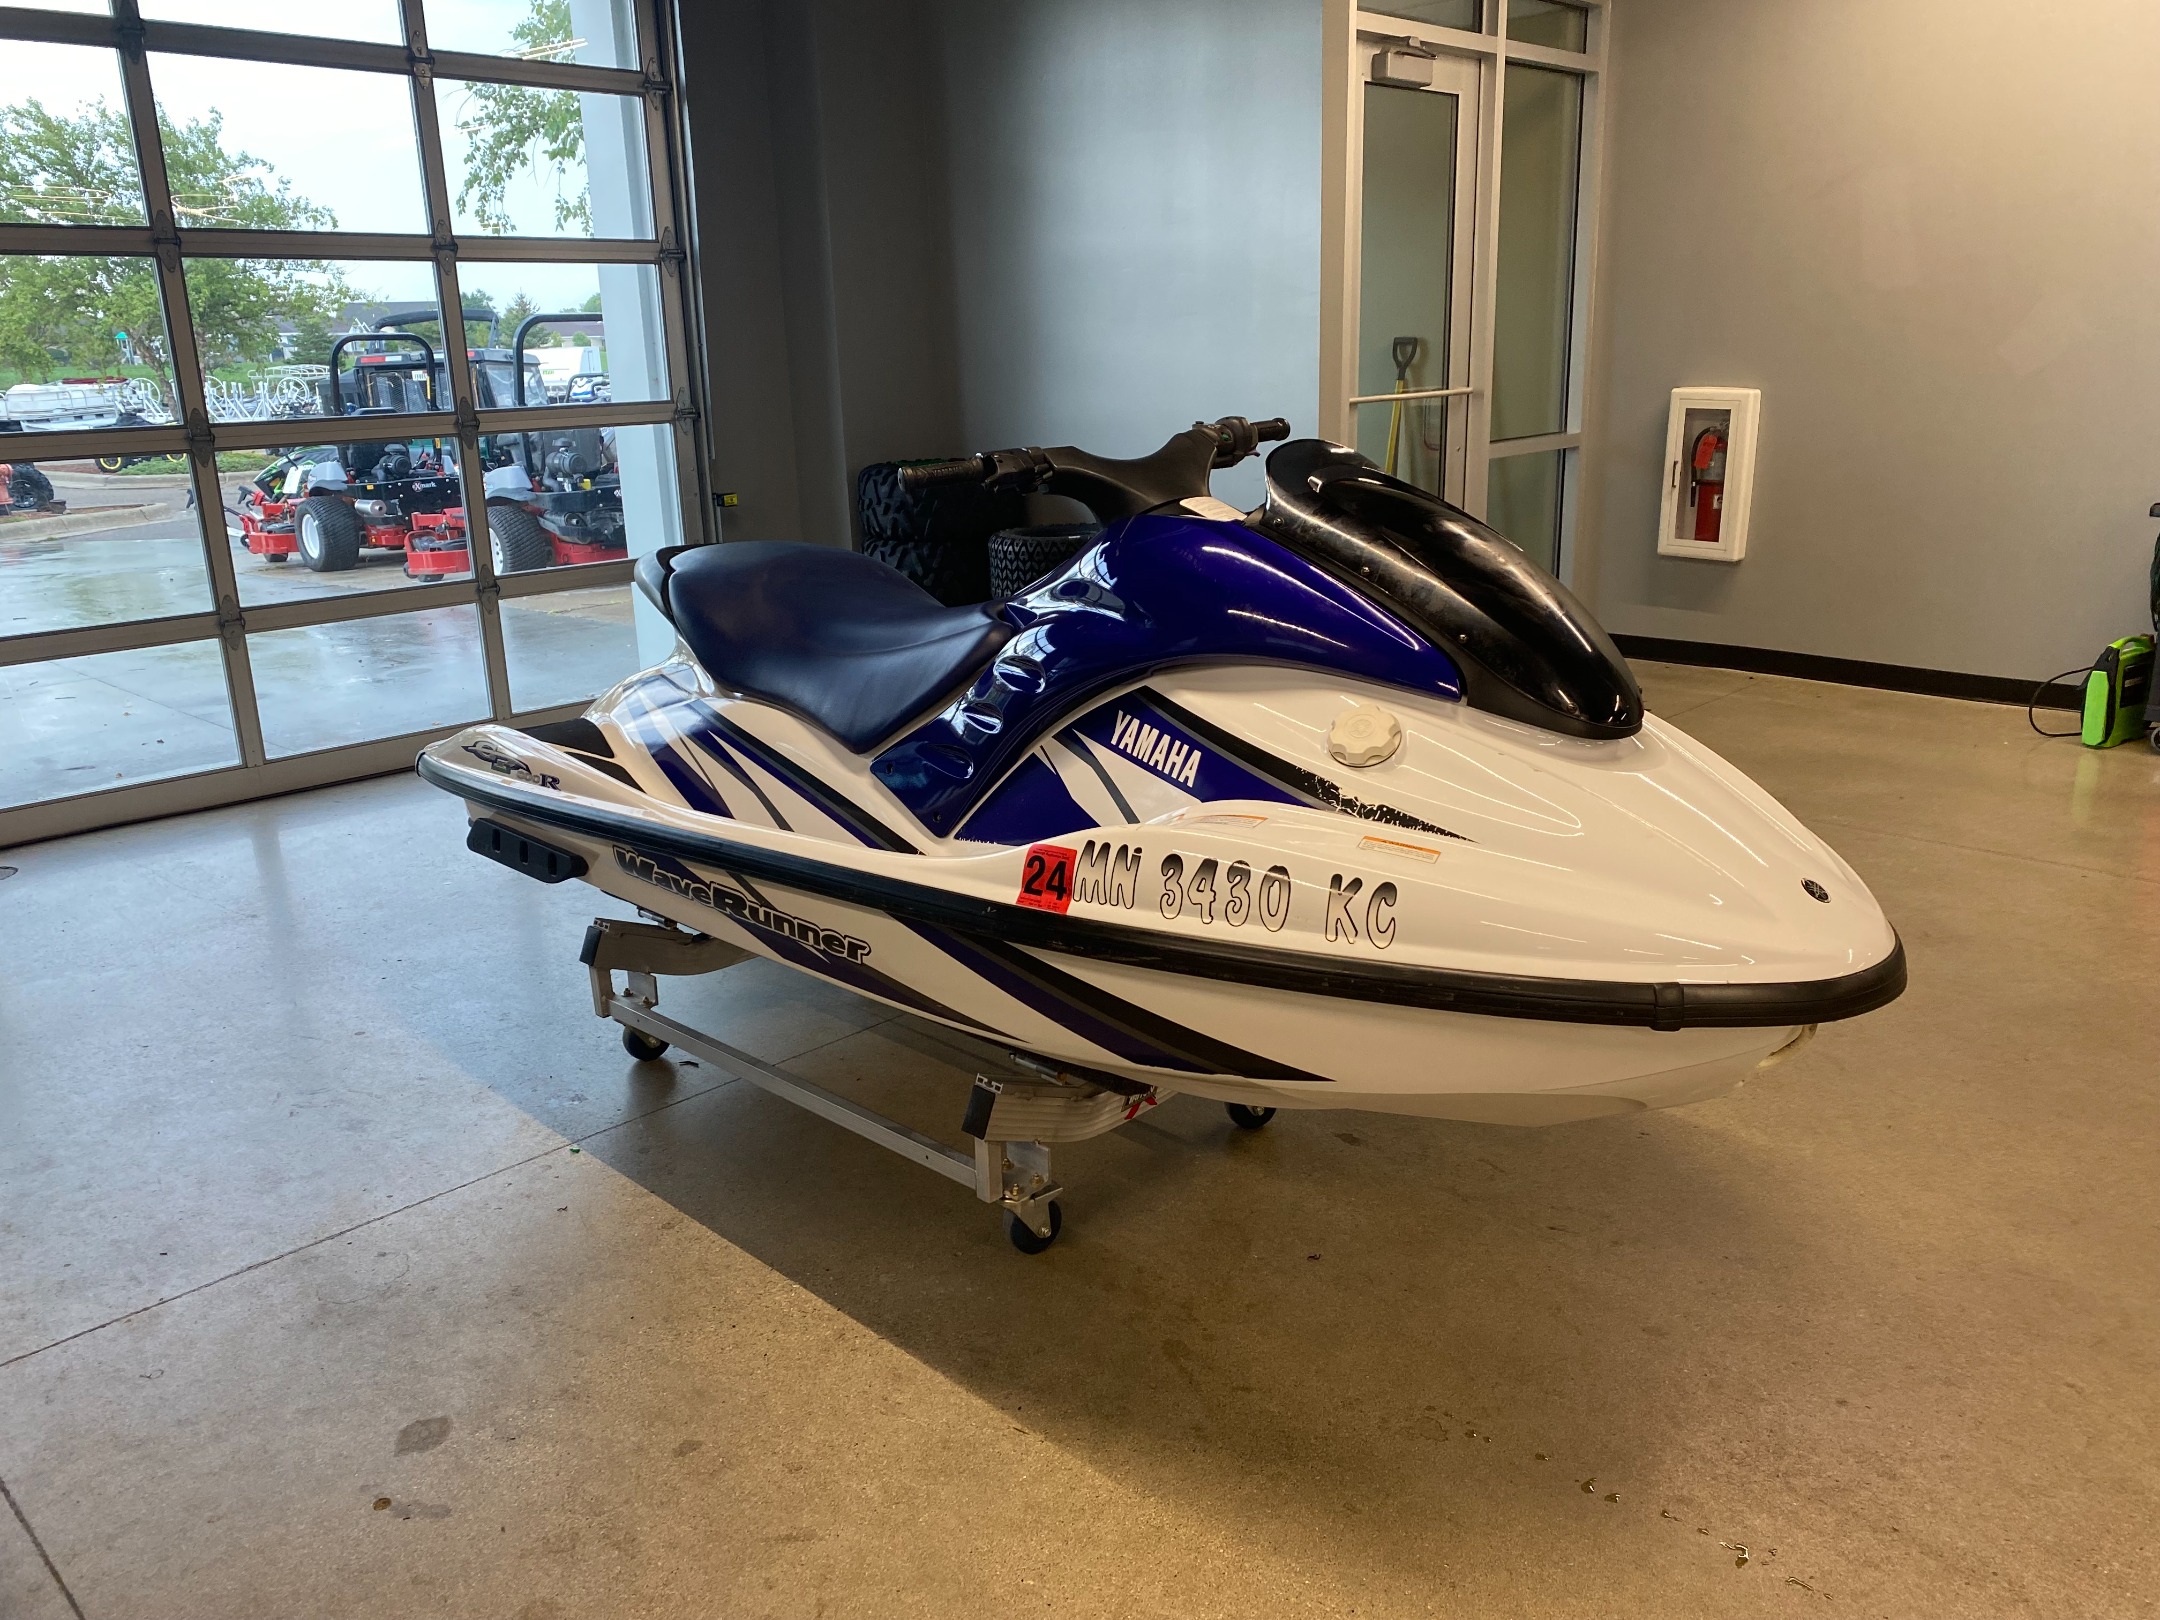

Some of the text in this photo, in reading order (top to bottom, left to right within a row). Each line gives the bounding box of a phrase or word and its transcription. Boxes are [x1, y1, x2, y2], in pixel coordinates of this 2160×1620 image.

[1110, 709, 1202, 788] YAMAHA
[613, 845, 872, 964] WaveRunner
[1023, 855, 1067, 901] 24
[1073, 839, 1397, 949] MN 3430 KC
